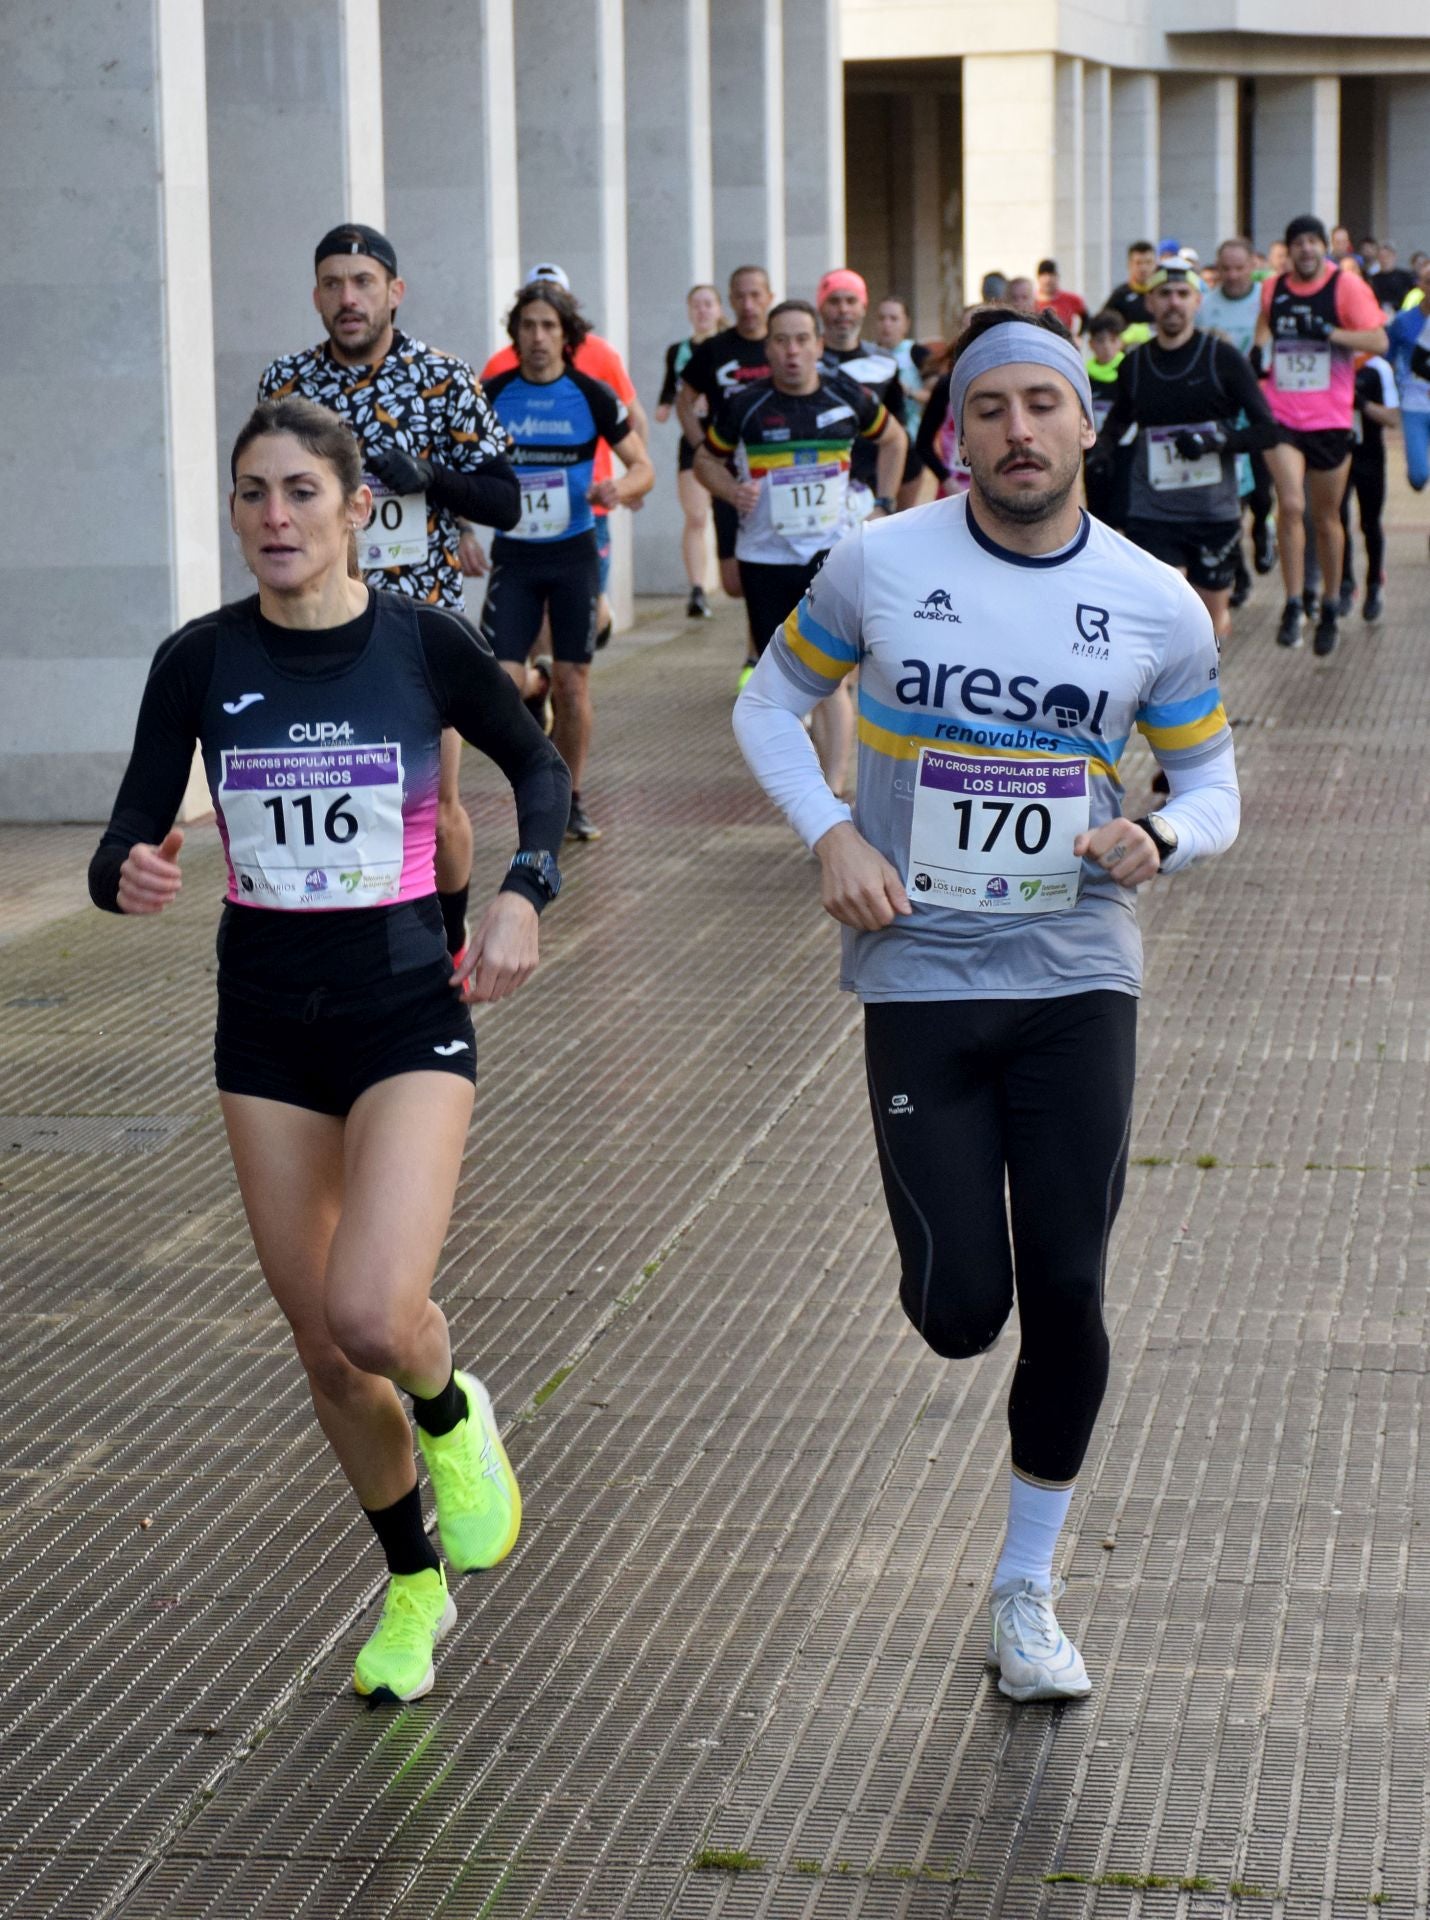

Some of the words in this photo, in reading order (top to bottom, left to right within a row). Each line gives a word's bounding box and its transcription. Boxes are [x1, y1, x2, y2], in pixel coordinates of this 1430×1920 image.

[1286, 353, 1316, 373] 152
[791, 483, 825, 508] 112
[1072, 642, 1109, 656] RIOJA
[895, 659, 1109, 736] aresol
[934, 720, 1060, 752] renovables
[247, 757, 281, 770] CROSS
[283, 755, 336, 769] POPULAR
[338, 754, 353, 766] DE
[355, 752, 391, 766] REYES
[927, 757, 943, 768] XVI
[945, 761, 981, 774] CROSS
[983, 765, 1034, 777] POPULAR
[1036, 767, 1050, 777] DE
[1052, 766, 1081, 777] REYES
[266, 772, 296, 787] LOS
[301, 770, 352, 786] LIRIOS
[963, 778, 994, 792] LOS
[999, 781, 1047, 795] LIRIOS
[263, 792, 359, 846] 116
[953, 799, 1051, 855] 170
[933, 881, 949, 891] LOS
[950, 884, 977, 896] LIRIOS
[979, 899, 993, 908] XVI
